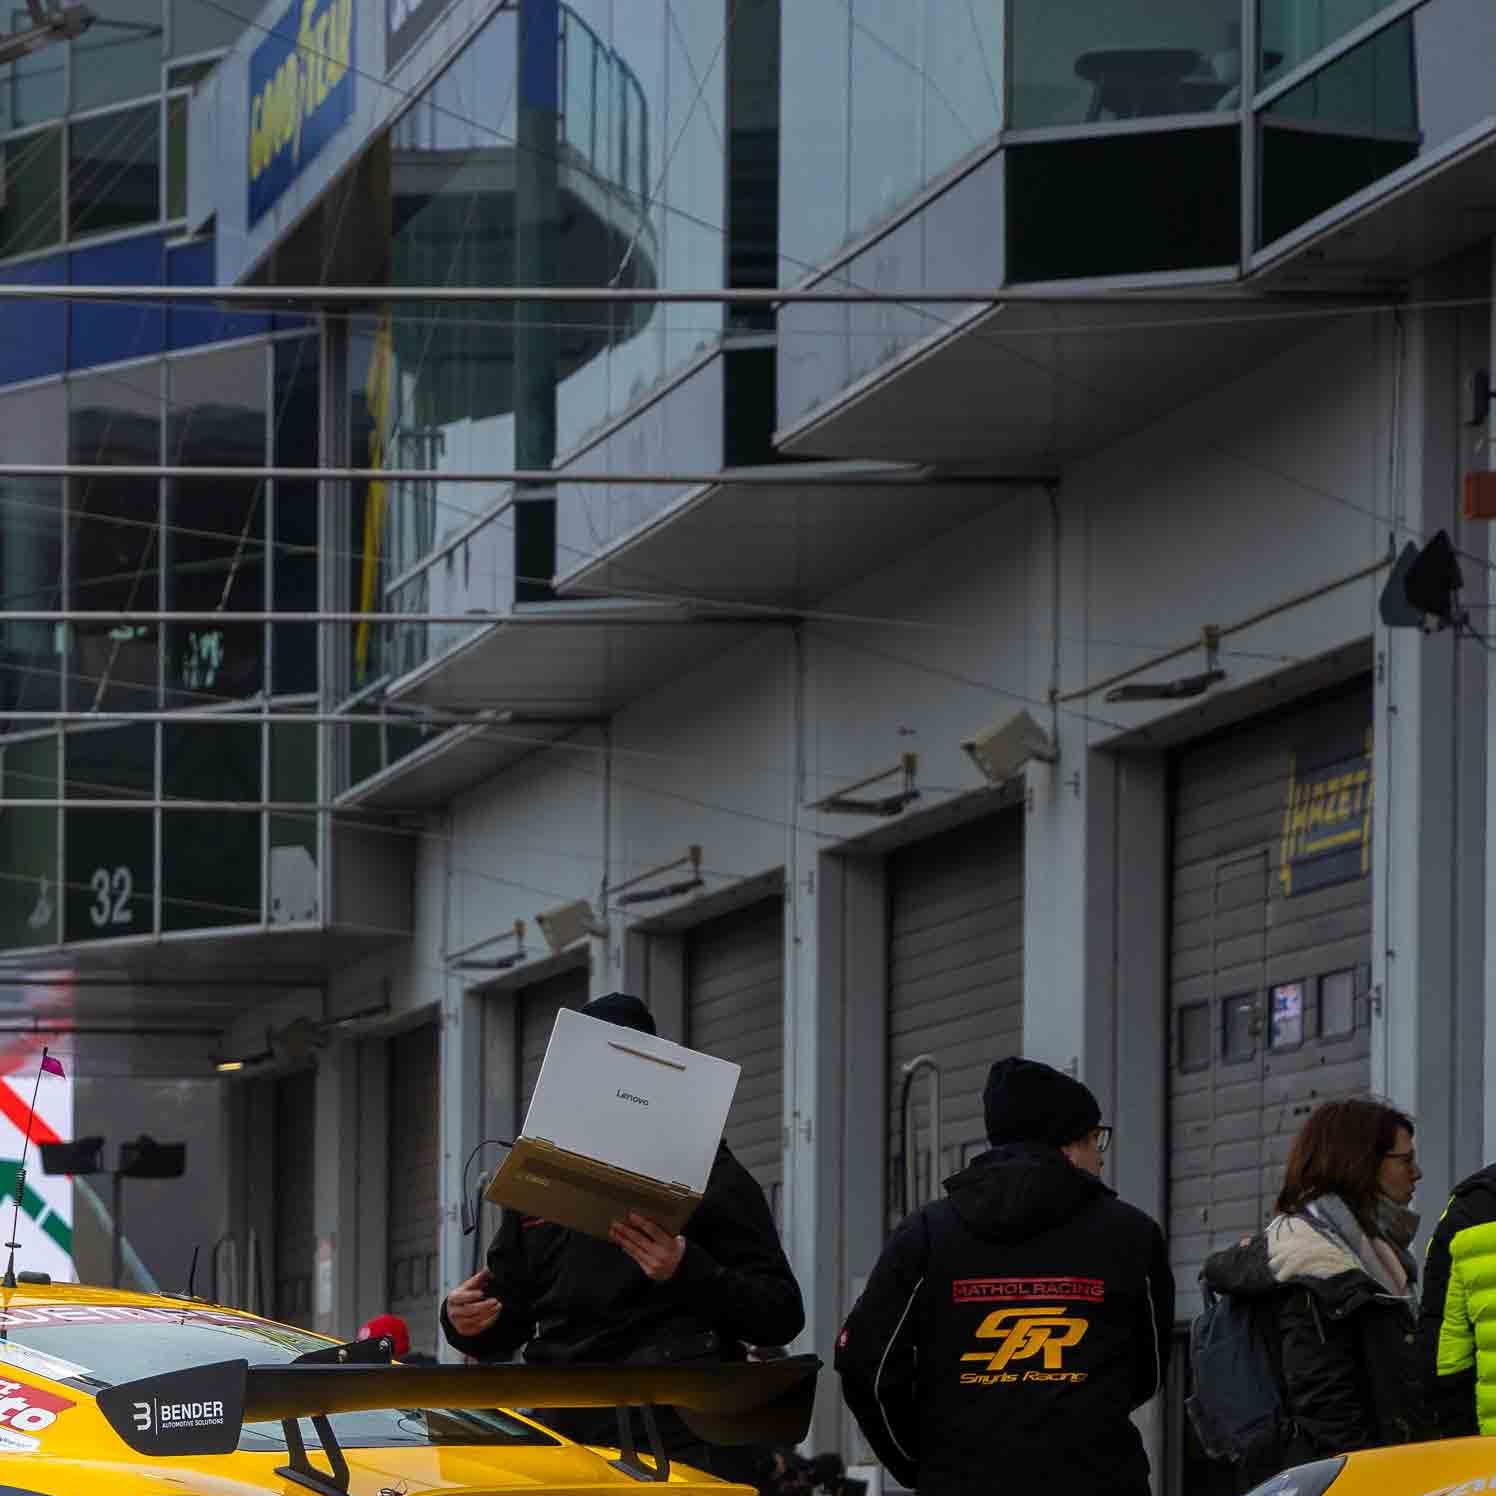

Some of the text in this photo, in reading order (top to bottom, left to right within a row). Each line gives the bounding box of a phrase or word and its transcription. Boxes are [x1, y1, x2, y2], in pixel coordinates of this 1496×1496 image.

[90, 865, 133, 925] 32
[616, 1089, 649, 1106] Lenovo
[1033, 1282, 1105, 1297] RACING
[161, 1401, 223, 1421] BENDER
[162, 1418, 224, 1429] AUTOMOTIVE SOLUTIONS
